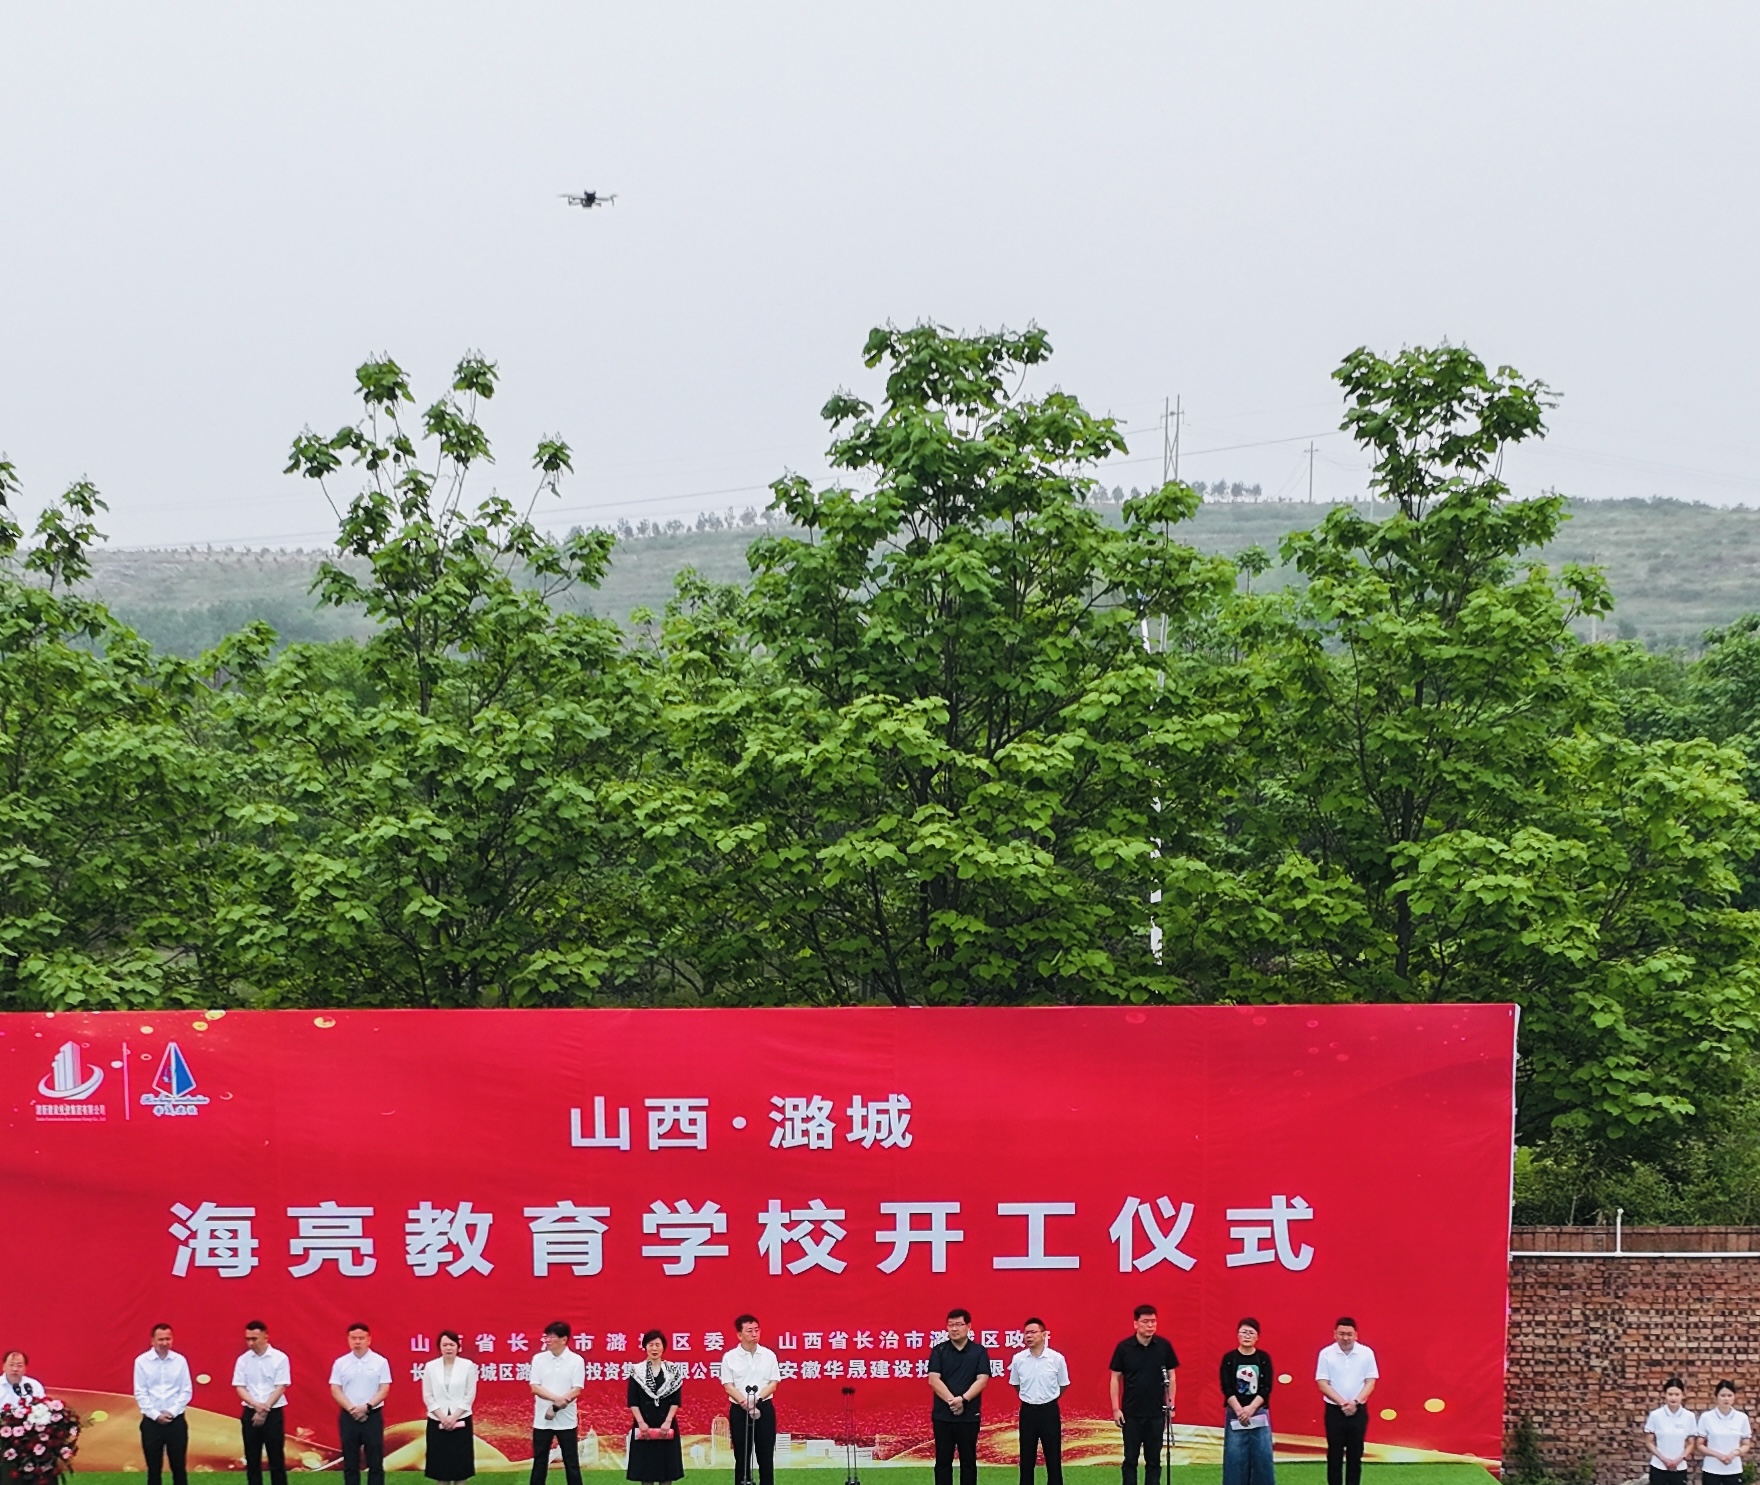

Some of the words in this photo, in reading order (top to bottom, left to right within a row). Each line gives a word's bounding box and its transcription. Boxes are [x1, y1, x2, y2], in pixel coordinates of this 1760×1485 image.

[570, 1094, 914, 1151] 山西·潞城
[168, 1195, 1316, 1278] 海亮教育学校开工仪式
[410, 1331, 726, 1353] 山省长市潞区委
[778, 1329, 1053, 1350] 山西省长治市潞区政
